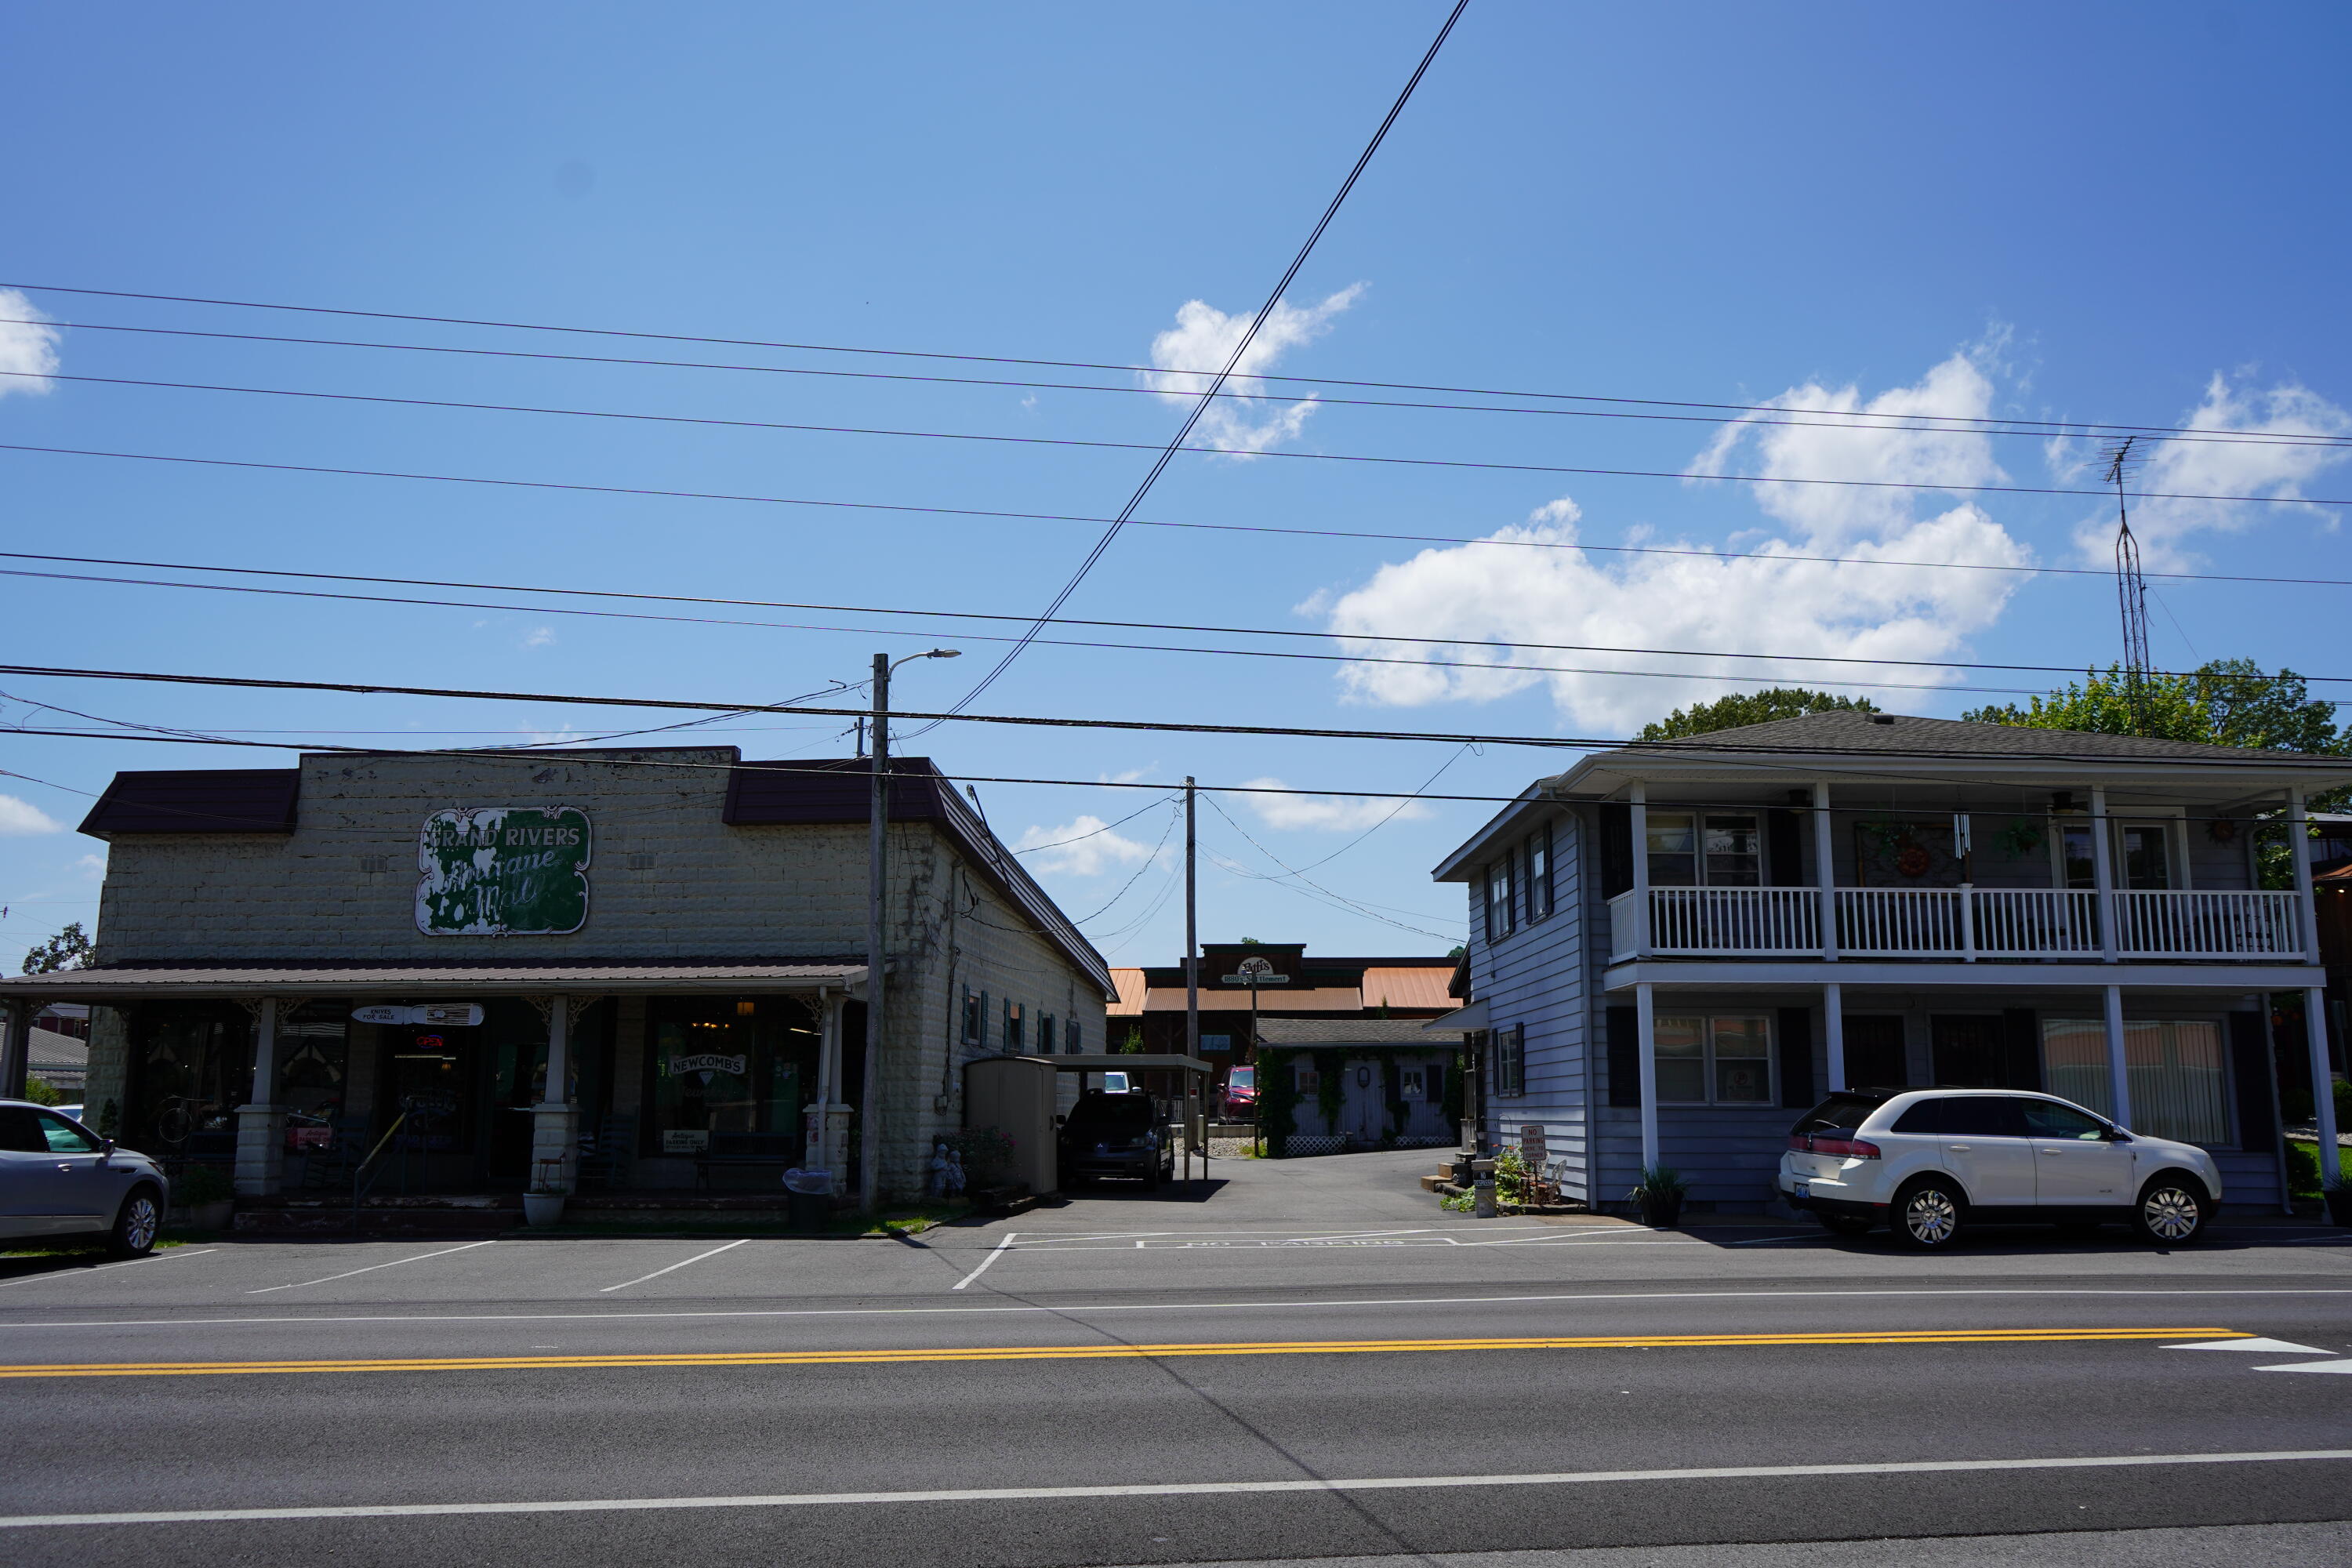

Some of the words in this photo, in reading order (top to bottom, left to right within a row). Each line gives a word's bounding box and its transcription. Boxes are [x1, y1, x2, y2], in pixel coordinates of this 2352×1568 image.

[430, 829, 498, 847] GRAND
[505, 827, 581, 847] RIVERS
[440, 850, 561, 895] Antique
[1241, 960, 1270, 973] Patti's
[416, 1036, 444, 1047] OPEN
[673, 1056, 741, 1073] NEWCOMB'S
[1480, 1171, 1486, 1180] NO
